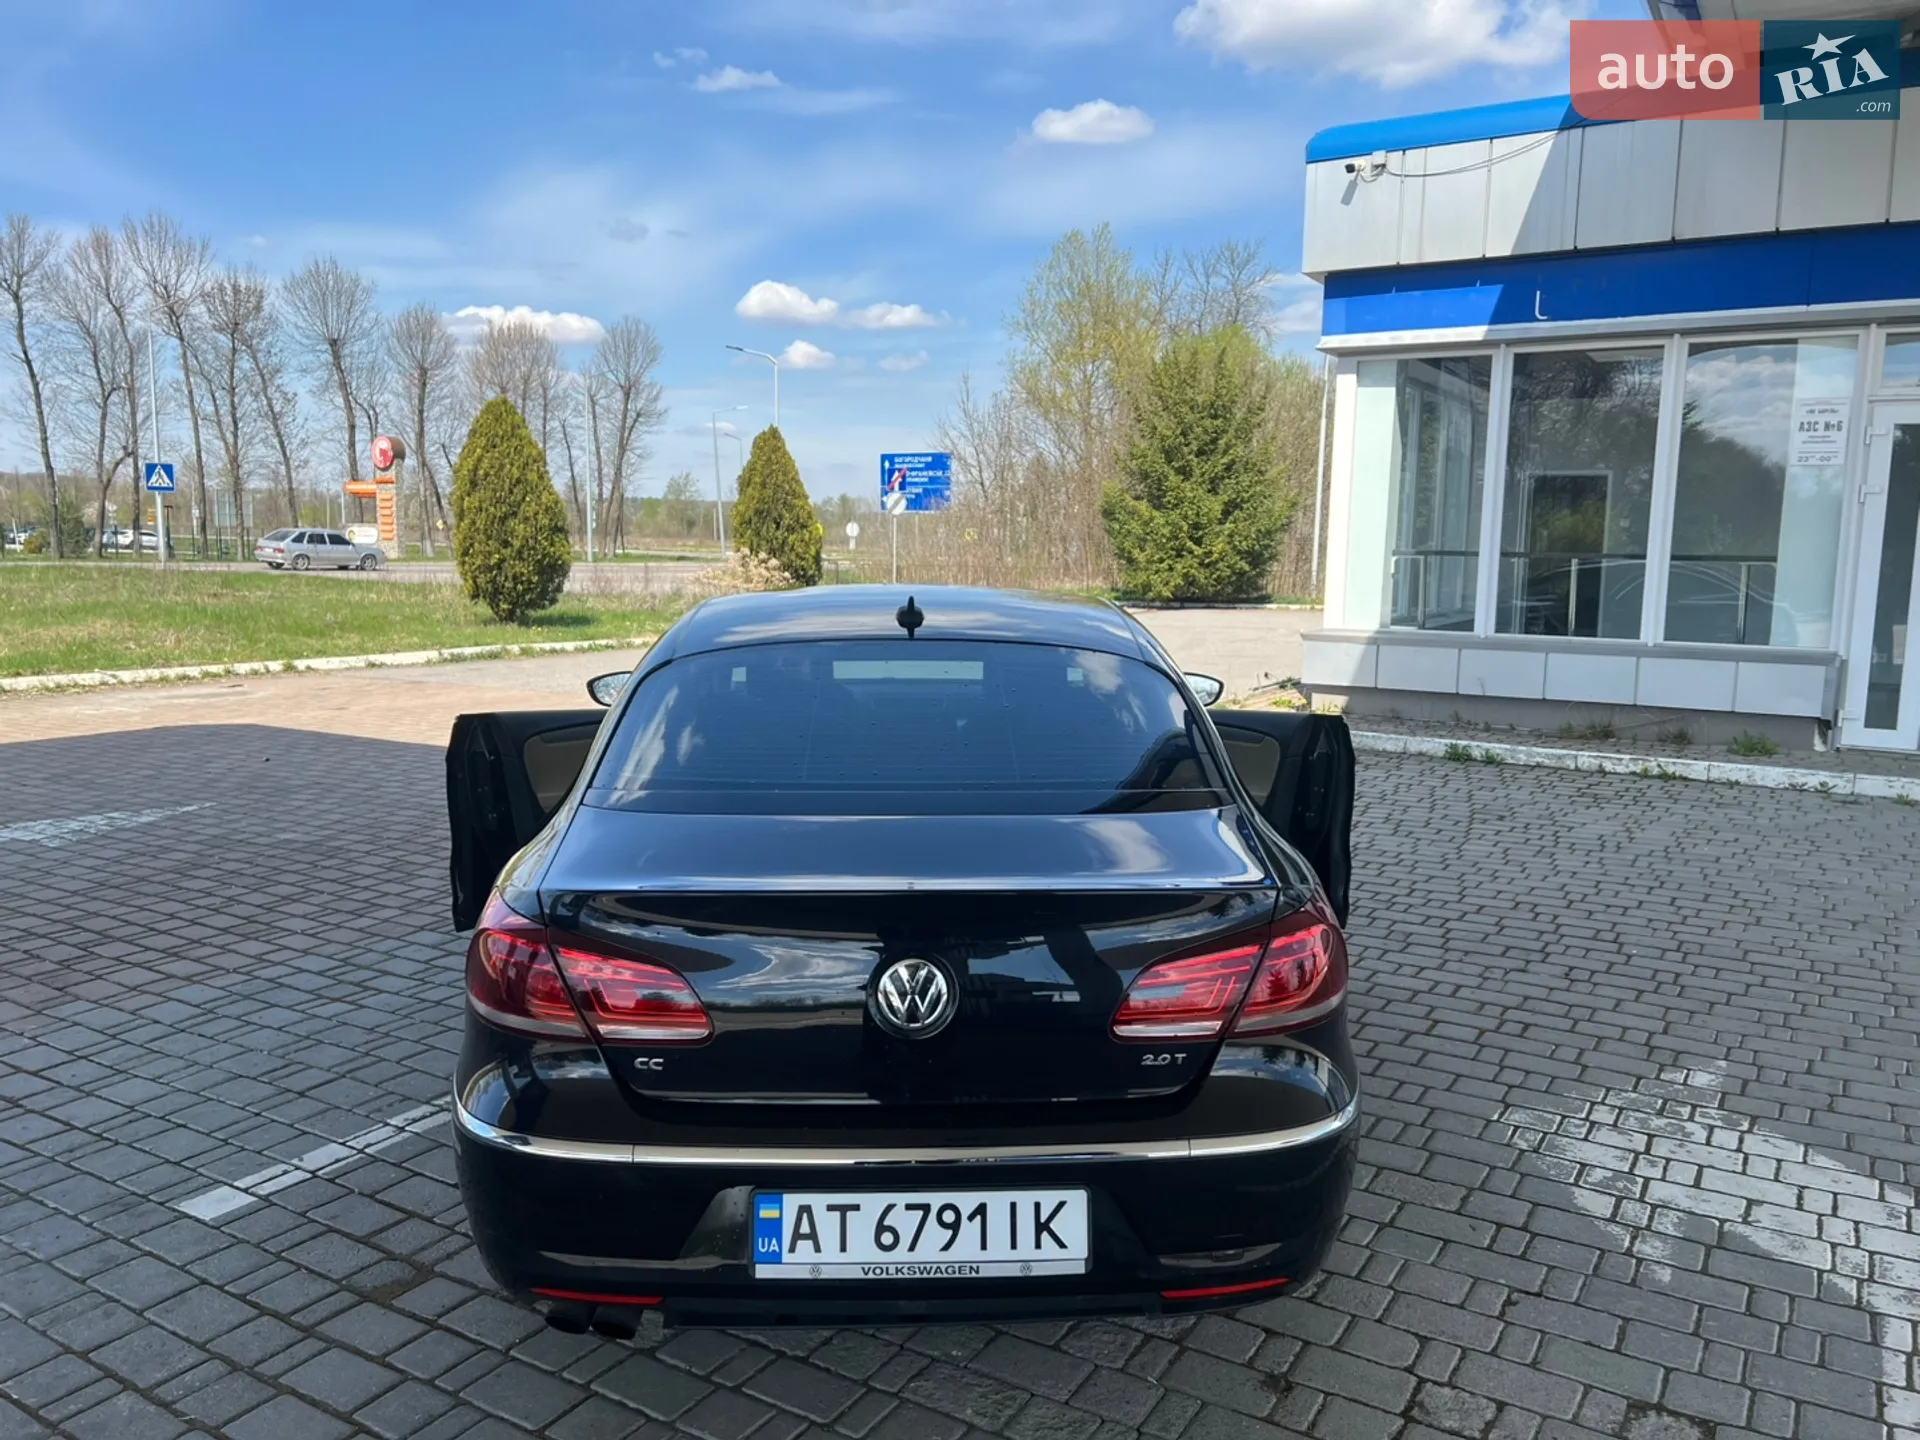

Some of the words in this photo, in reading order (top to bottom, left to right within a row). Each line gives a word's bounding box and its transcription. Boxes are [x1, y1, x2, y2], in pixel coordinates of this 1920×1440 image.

[1798, 420, 1820, 433] АЗС
[634, 1057, 664, 1070] CC
[873, 1202, 988, 1253] 6791
[758, 1237, 780, 1253] UA
[861, 1264, 980, 1277] VOLKSWAGEN
